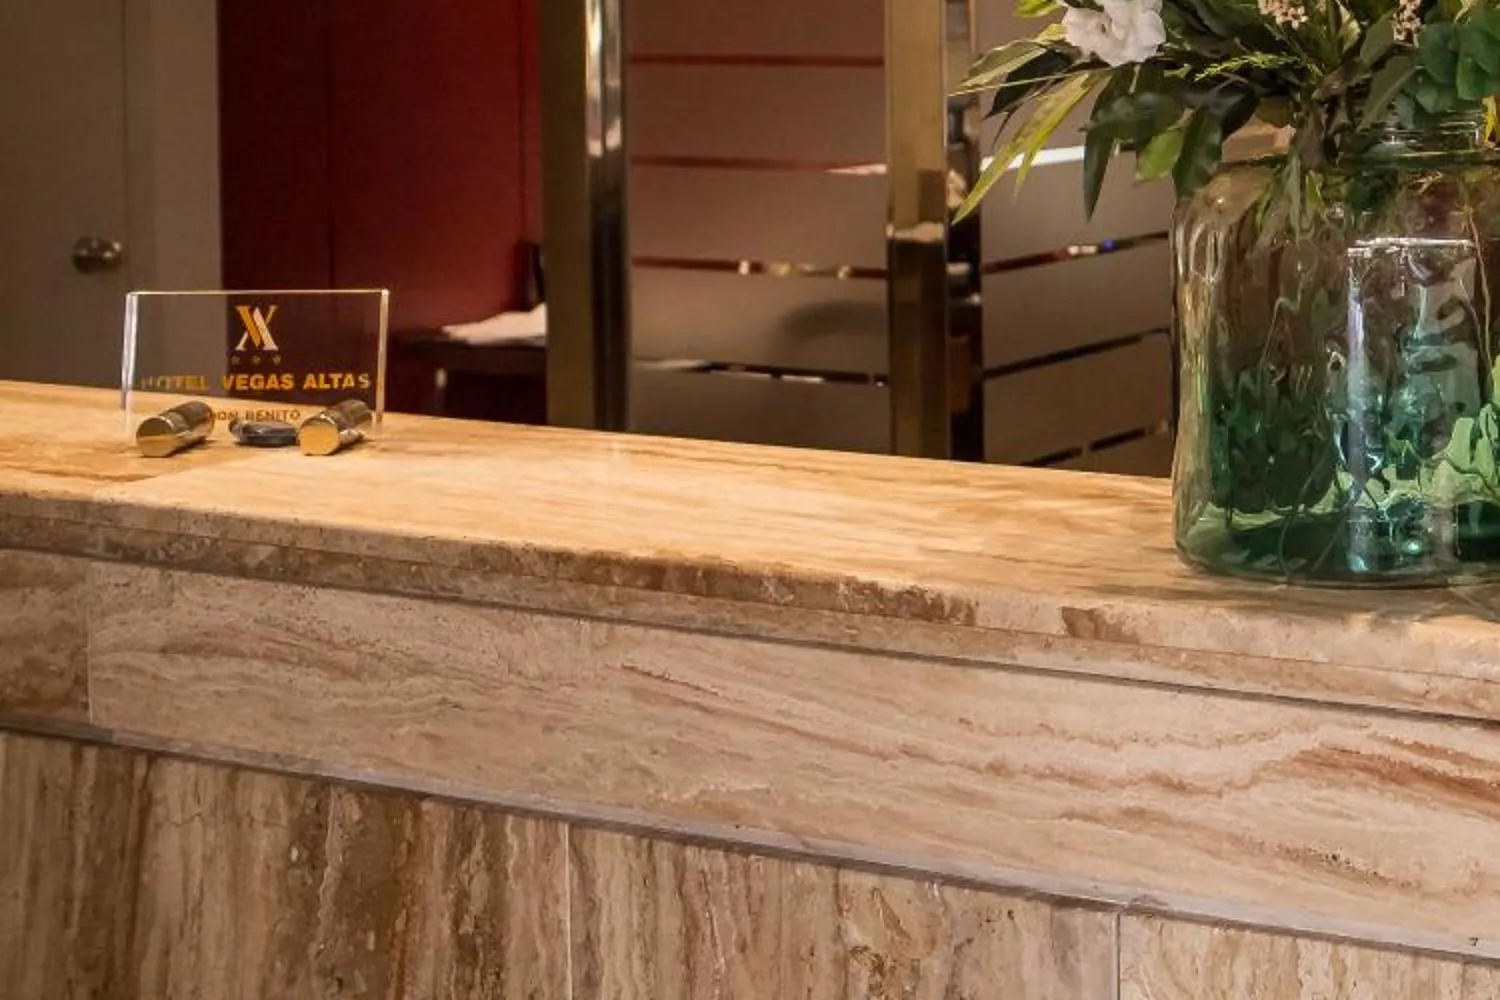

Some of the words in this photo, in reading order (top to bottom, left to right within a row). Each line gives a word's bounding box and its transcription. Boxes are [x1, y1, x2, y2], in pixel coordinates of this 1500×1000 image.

[141, 374, 209, 390] HOTEL
[223, 373, 295, 391] VEGAS
[303, 372, 372, 390] ALTAS
